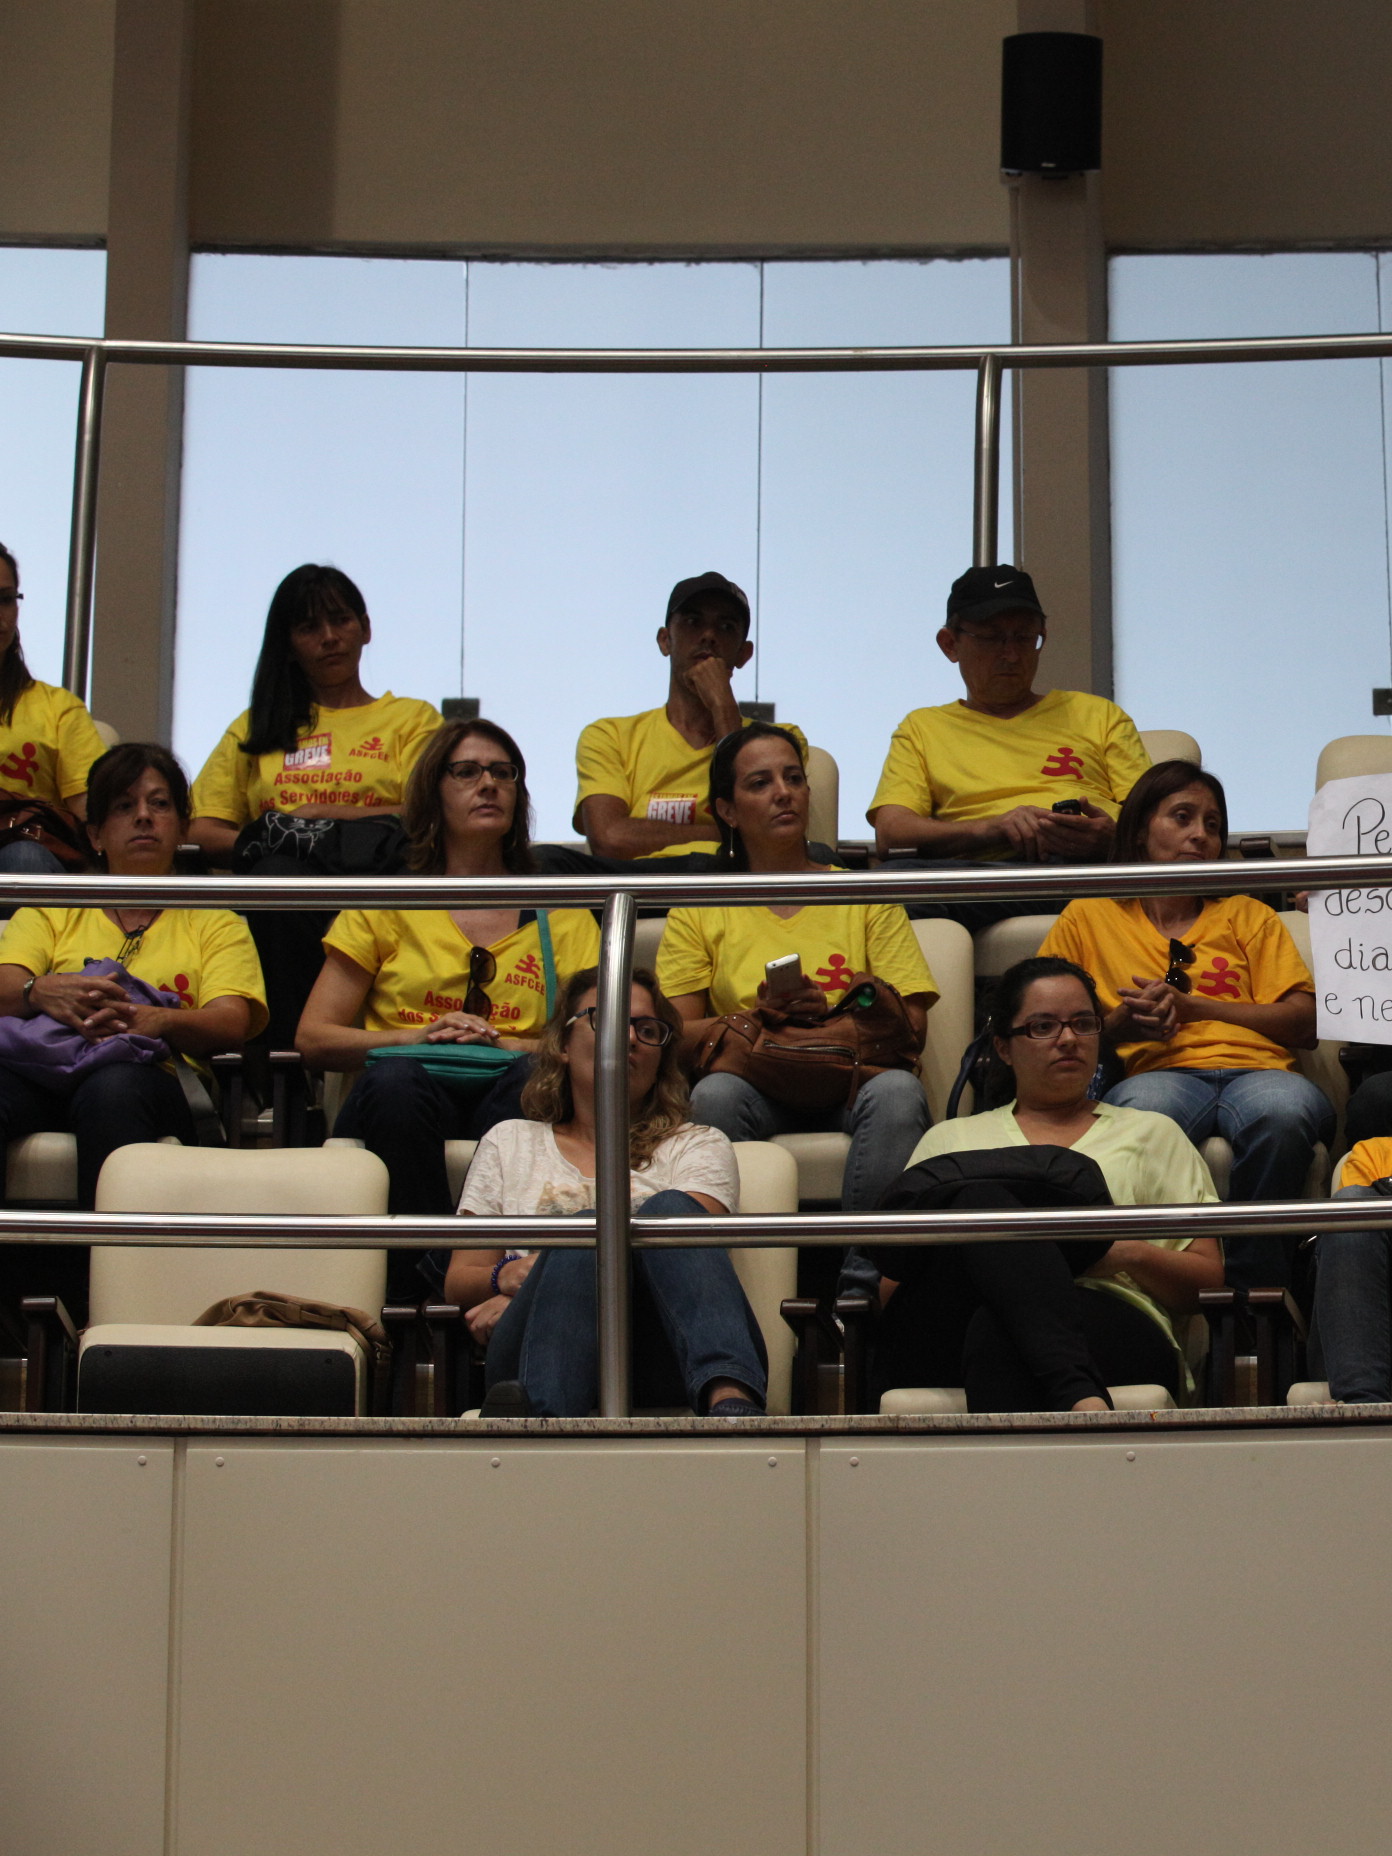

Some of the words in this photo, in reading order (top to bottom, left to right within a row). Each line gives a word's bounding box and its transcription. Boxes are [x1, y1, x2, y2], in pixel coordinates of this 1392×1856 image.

[284, 744, 330, 766] GREVE
[274, 768, 363, 786] Associação
[280, 788, 361, 806] Servidores
[648, 801, 693, 824] GREVE
[504, 972, 546, 997] ASFCEE
[1325, 991, 1343, 1015] e
